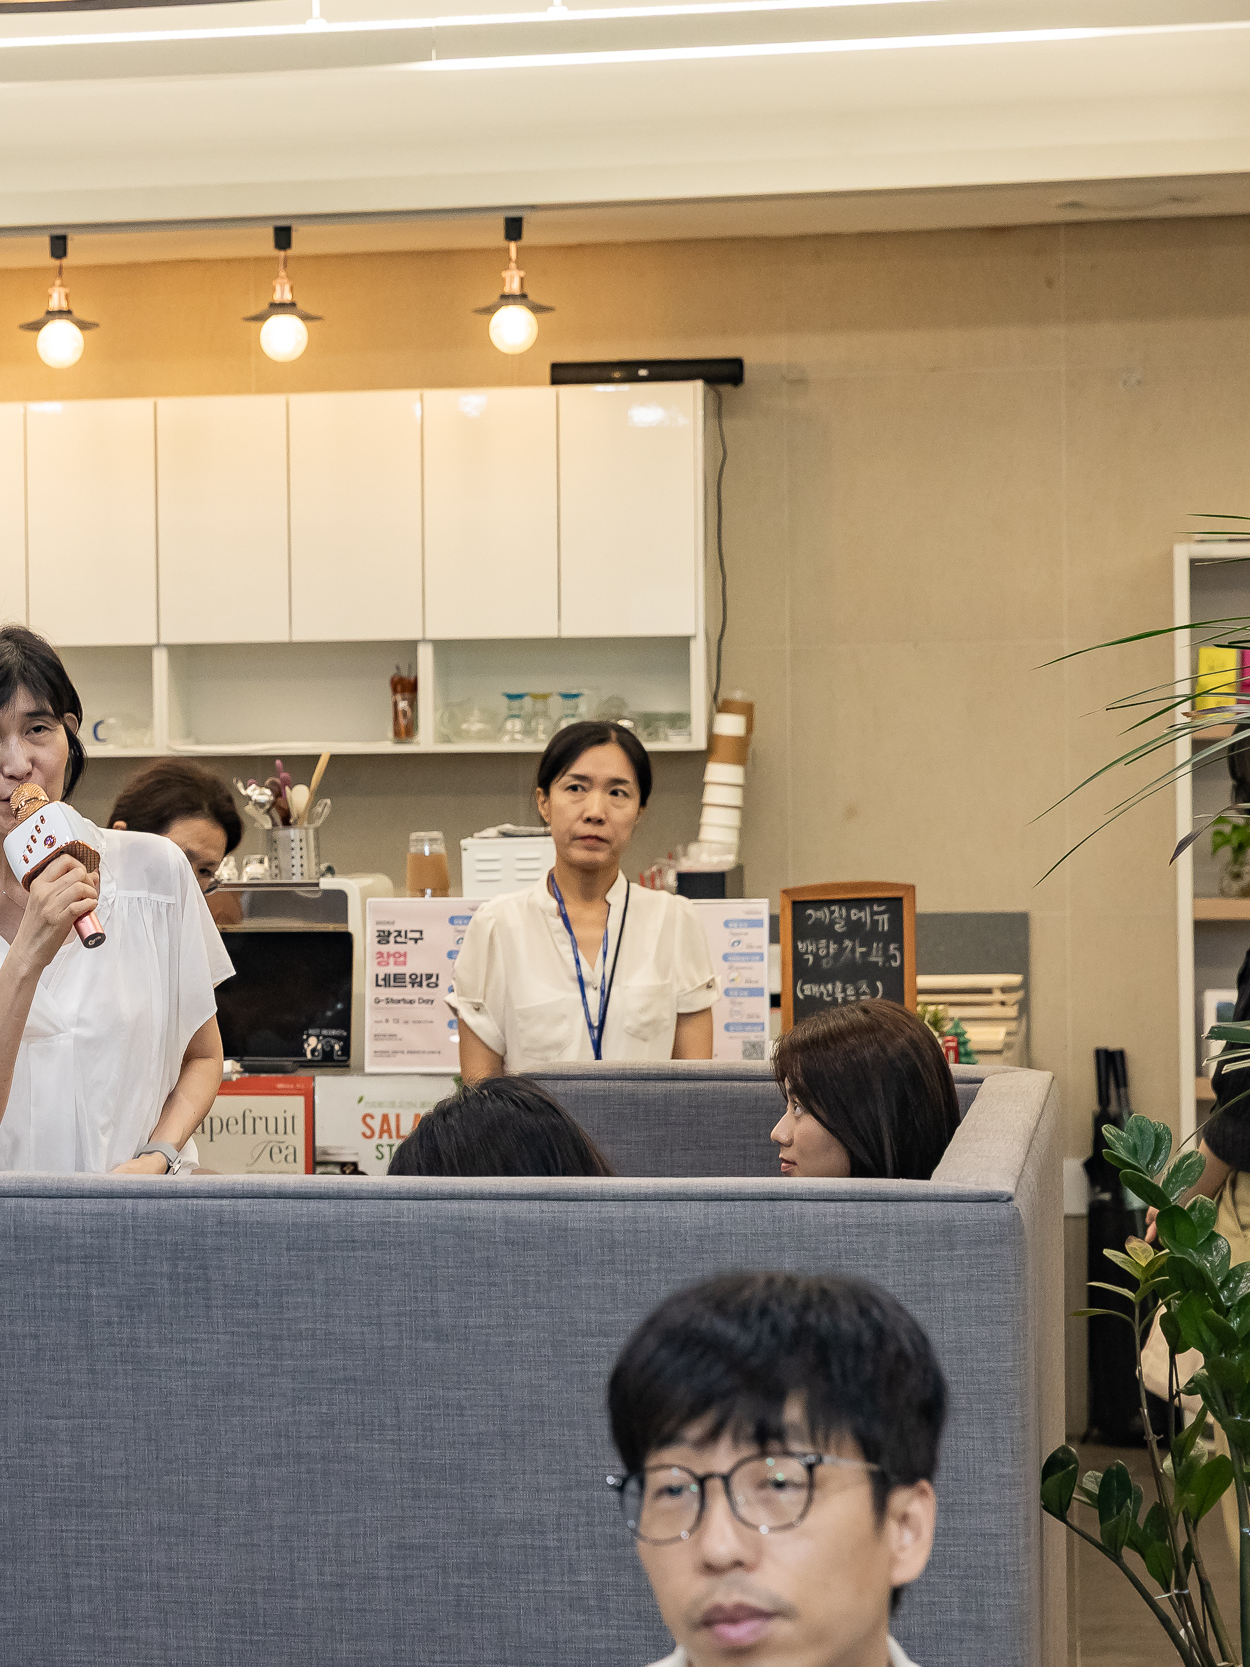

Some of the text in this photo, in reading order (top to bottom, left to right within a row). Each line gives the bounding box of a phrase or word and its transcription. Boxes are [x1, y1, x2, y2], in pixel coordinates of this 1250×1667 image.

[375, 929, 424, 945] 광진구
[375, 951, 408, 967] 창업
[374, 972, 440, 989] 네트워킹
[417, 997, 435, 1006] Day
[246, 1140, 298, 1167] Tea
[375, 1143, 402, 1161] ST
